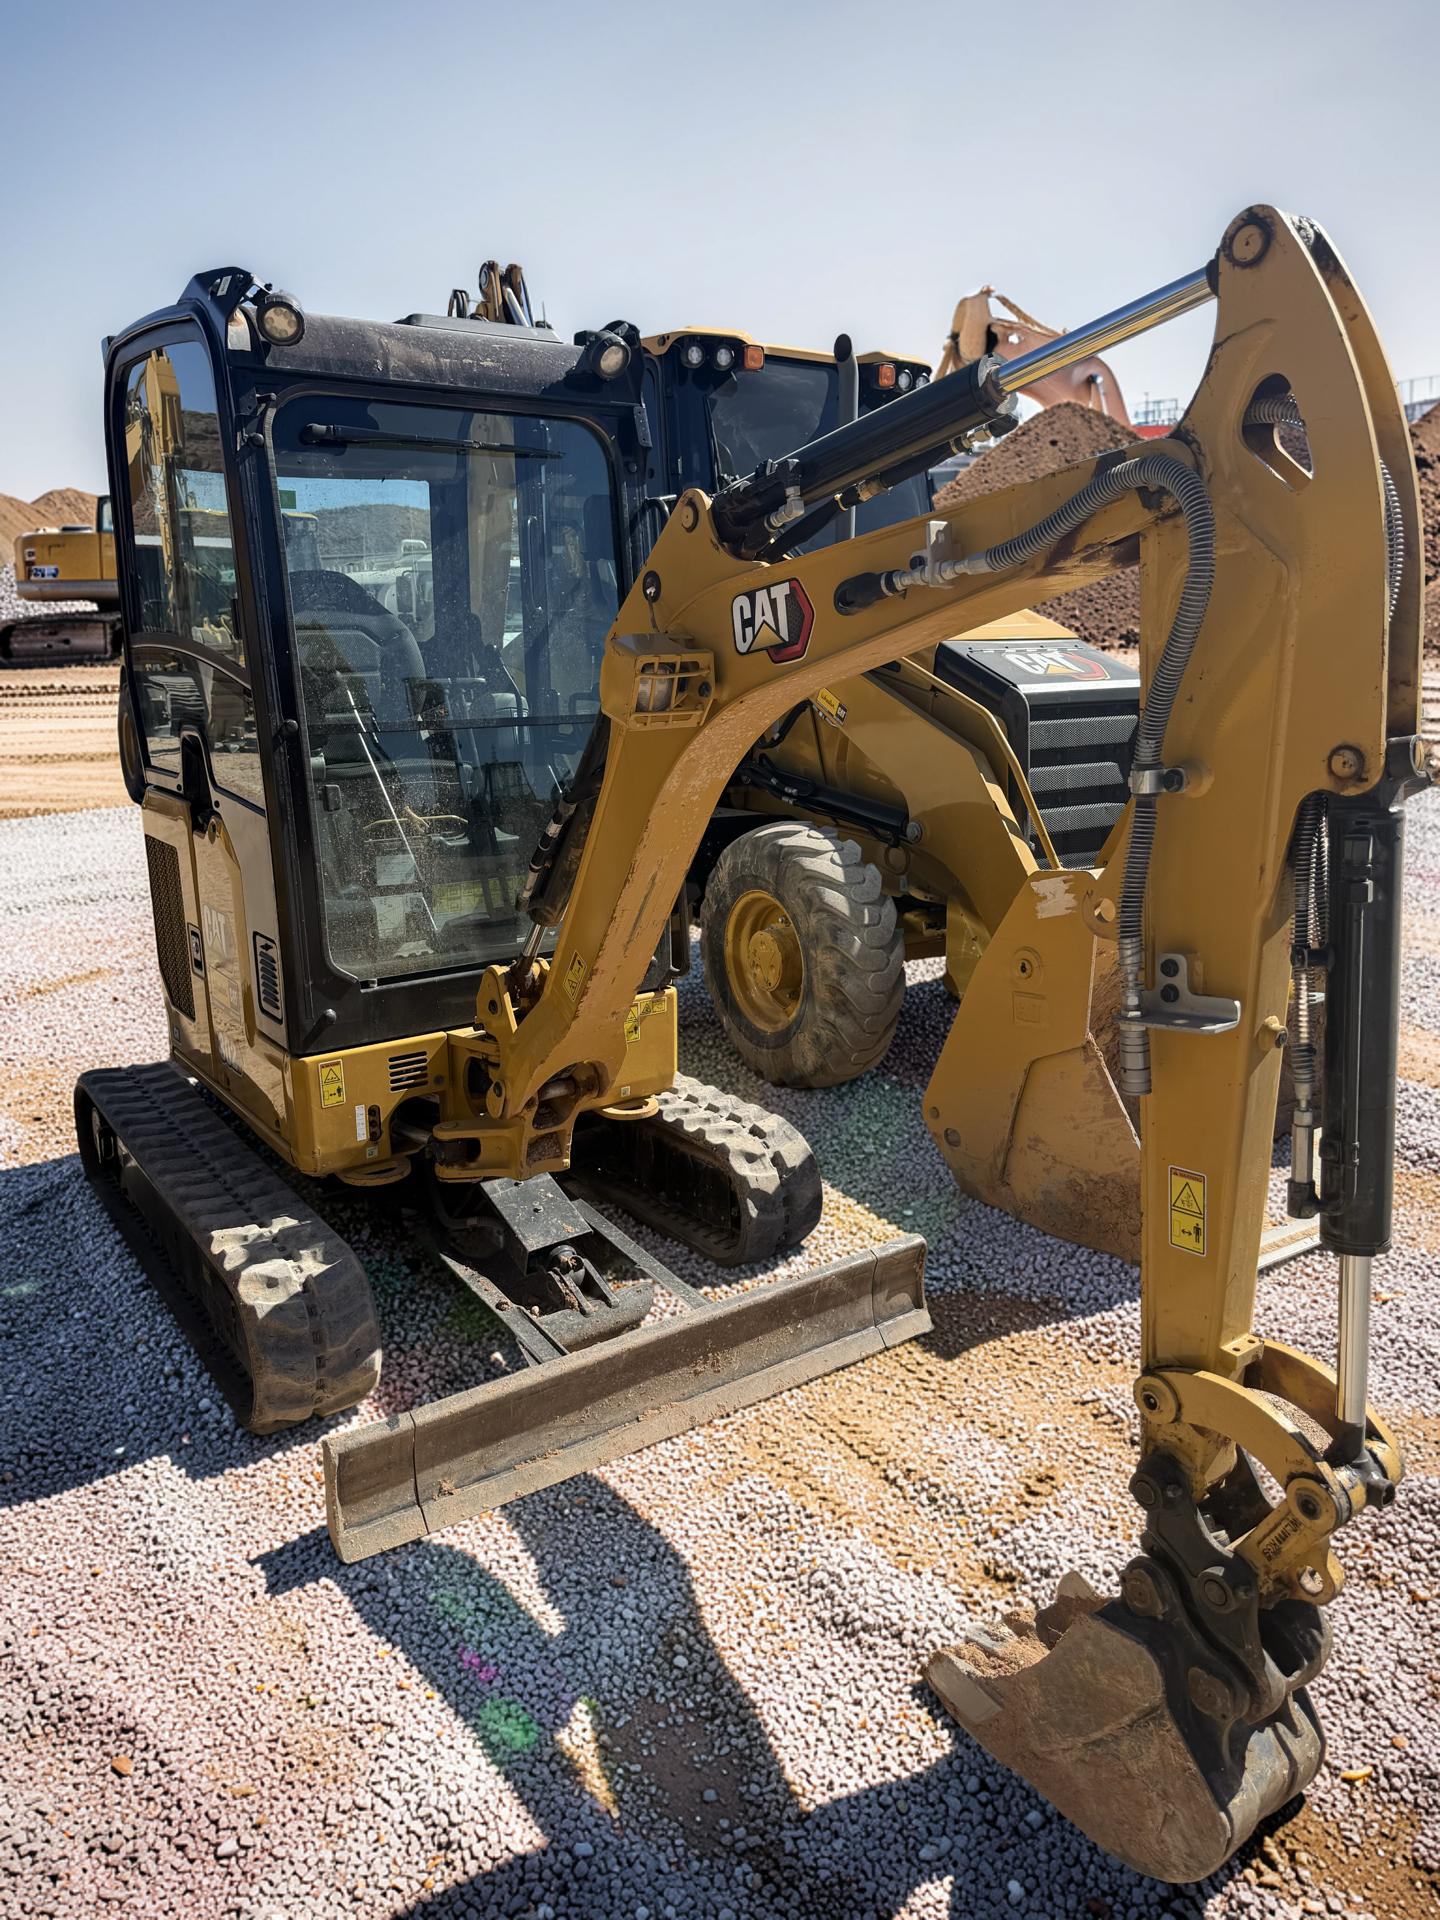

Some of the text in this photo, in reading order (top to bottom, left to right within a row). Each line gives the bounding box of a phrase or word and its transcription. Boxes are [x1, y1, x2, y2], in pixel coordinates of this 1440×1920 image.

[733, 581, 790, 653] CAT
[1001, 651, 1085, 675] CAT
[203, 904, 228, 958] CAT
